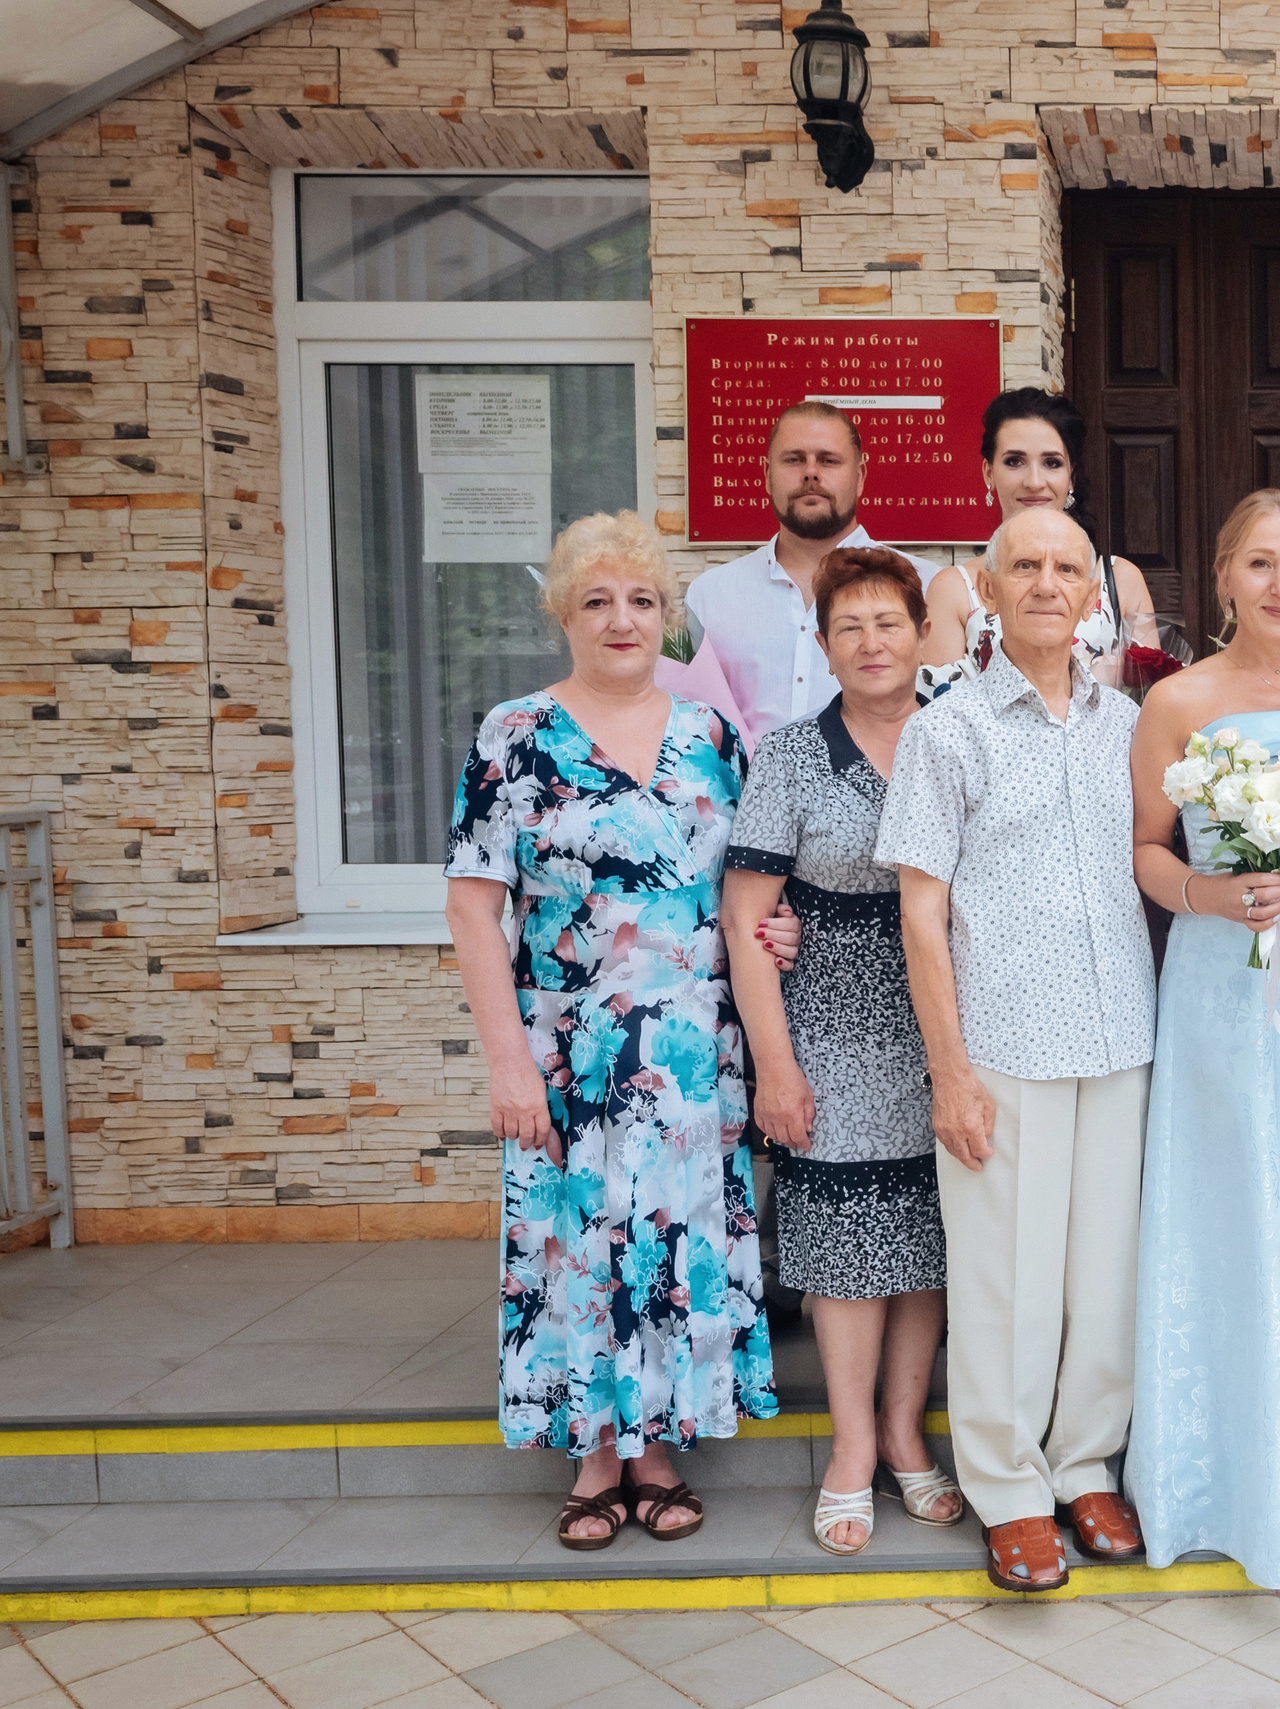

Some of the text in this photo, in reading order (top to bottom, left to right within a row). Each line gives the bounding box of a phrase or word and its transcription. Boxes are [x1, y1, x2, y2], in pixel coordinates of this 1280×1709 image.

[766, 333, 918, 349] Режим работы
[711, 358, 942, 372] Вторник: с 8.00 до 17.00
[711, 376, 942, 391] Среда: с 8.00 до 17.00
[711, 396, 790, 410] Четверг:
[712, 415, 779, 426] Пятниц
[869, 416, 888, 426] до
[896, 414, 946, 425] 16.00
[712, 433, 944, 448] Суббо до 17.00
[713, 453, 767, 466] Перер
[878, 455, 897, 463] до
[905, 452, 952, 463] 12.50
[713, 476, 762, 487] Выхо
[713, 495, 977, 509] Воскр онедельник
